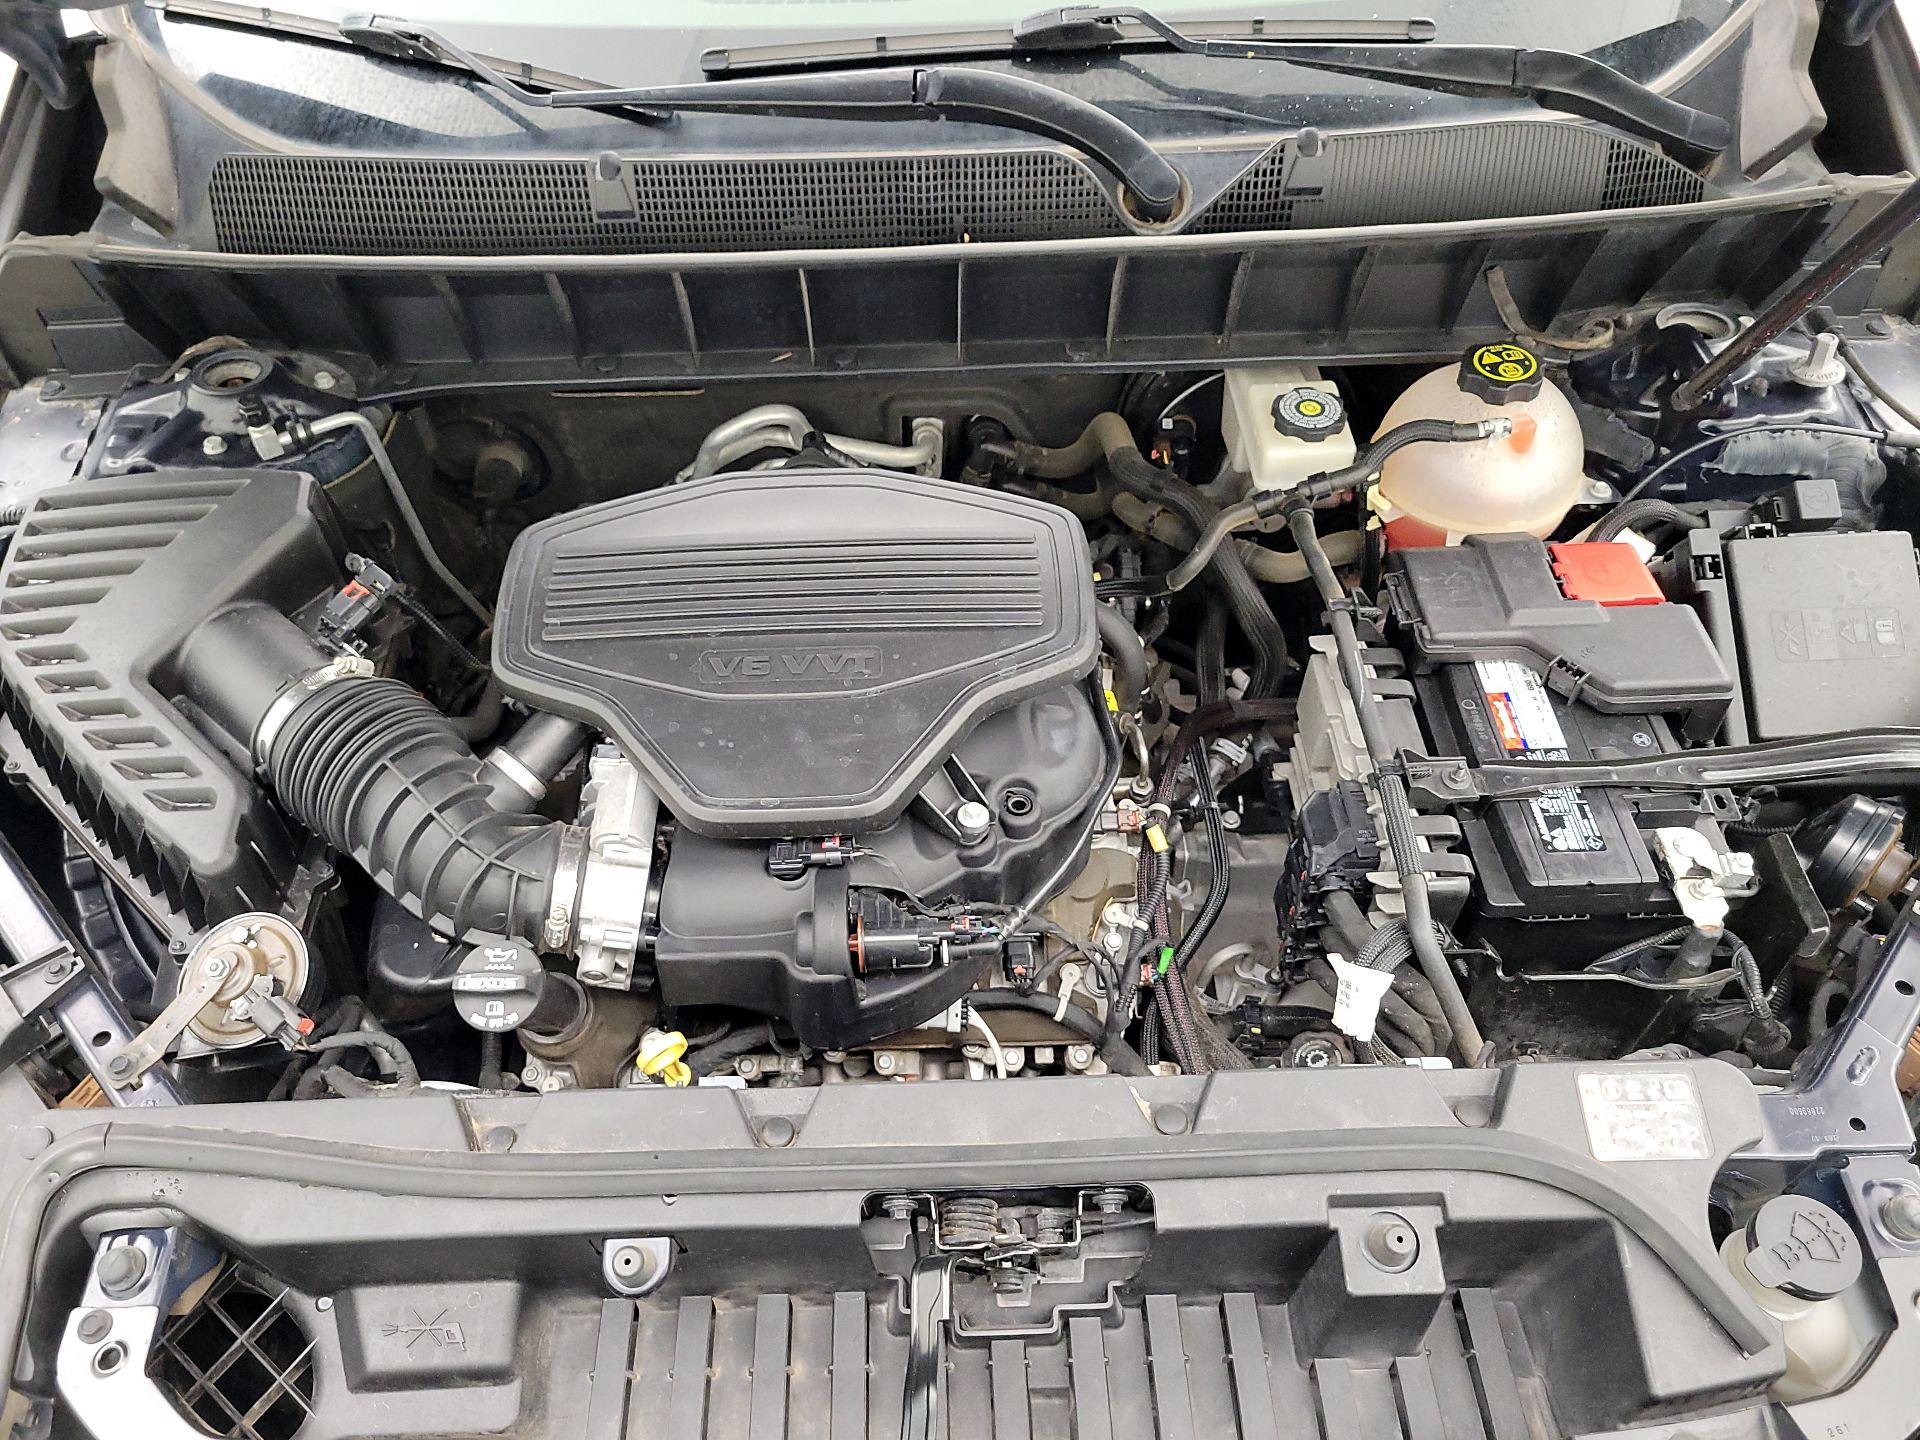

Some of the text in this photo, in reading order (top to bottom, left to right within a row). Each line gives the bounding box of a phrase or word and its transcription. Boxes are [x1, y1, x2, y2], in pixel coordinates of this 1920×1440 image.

[708, 653, 875, 677] V6 VVT
[458, 974, 519, 990] dexos
[1827, 1423, 1850, 1438] 261
